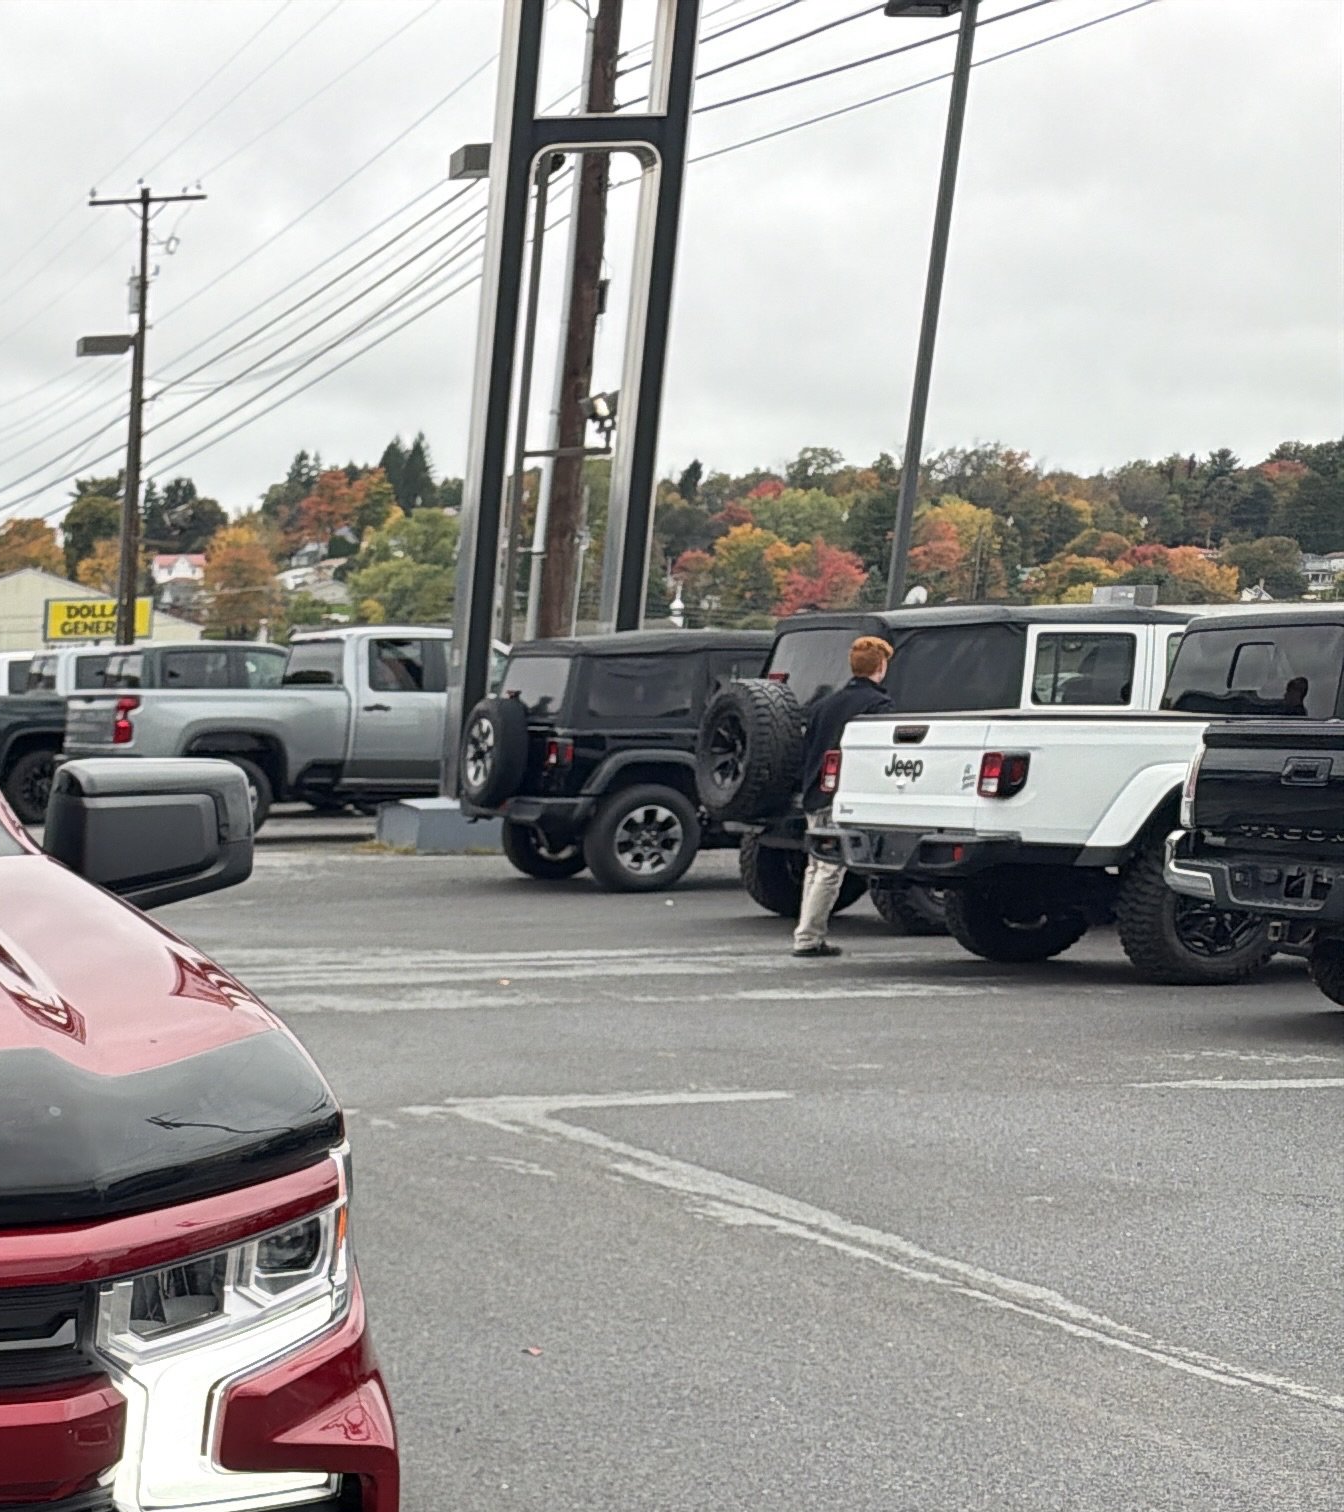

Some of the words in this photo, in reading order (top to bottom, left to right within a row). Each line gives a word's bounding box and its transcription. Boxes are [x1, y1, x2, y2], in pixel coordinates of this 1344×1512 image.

[67, 604, 118, 618] DOLL
[61, 621, 118, 635] GENER
[885, 753, 924, 782] Jeep
